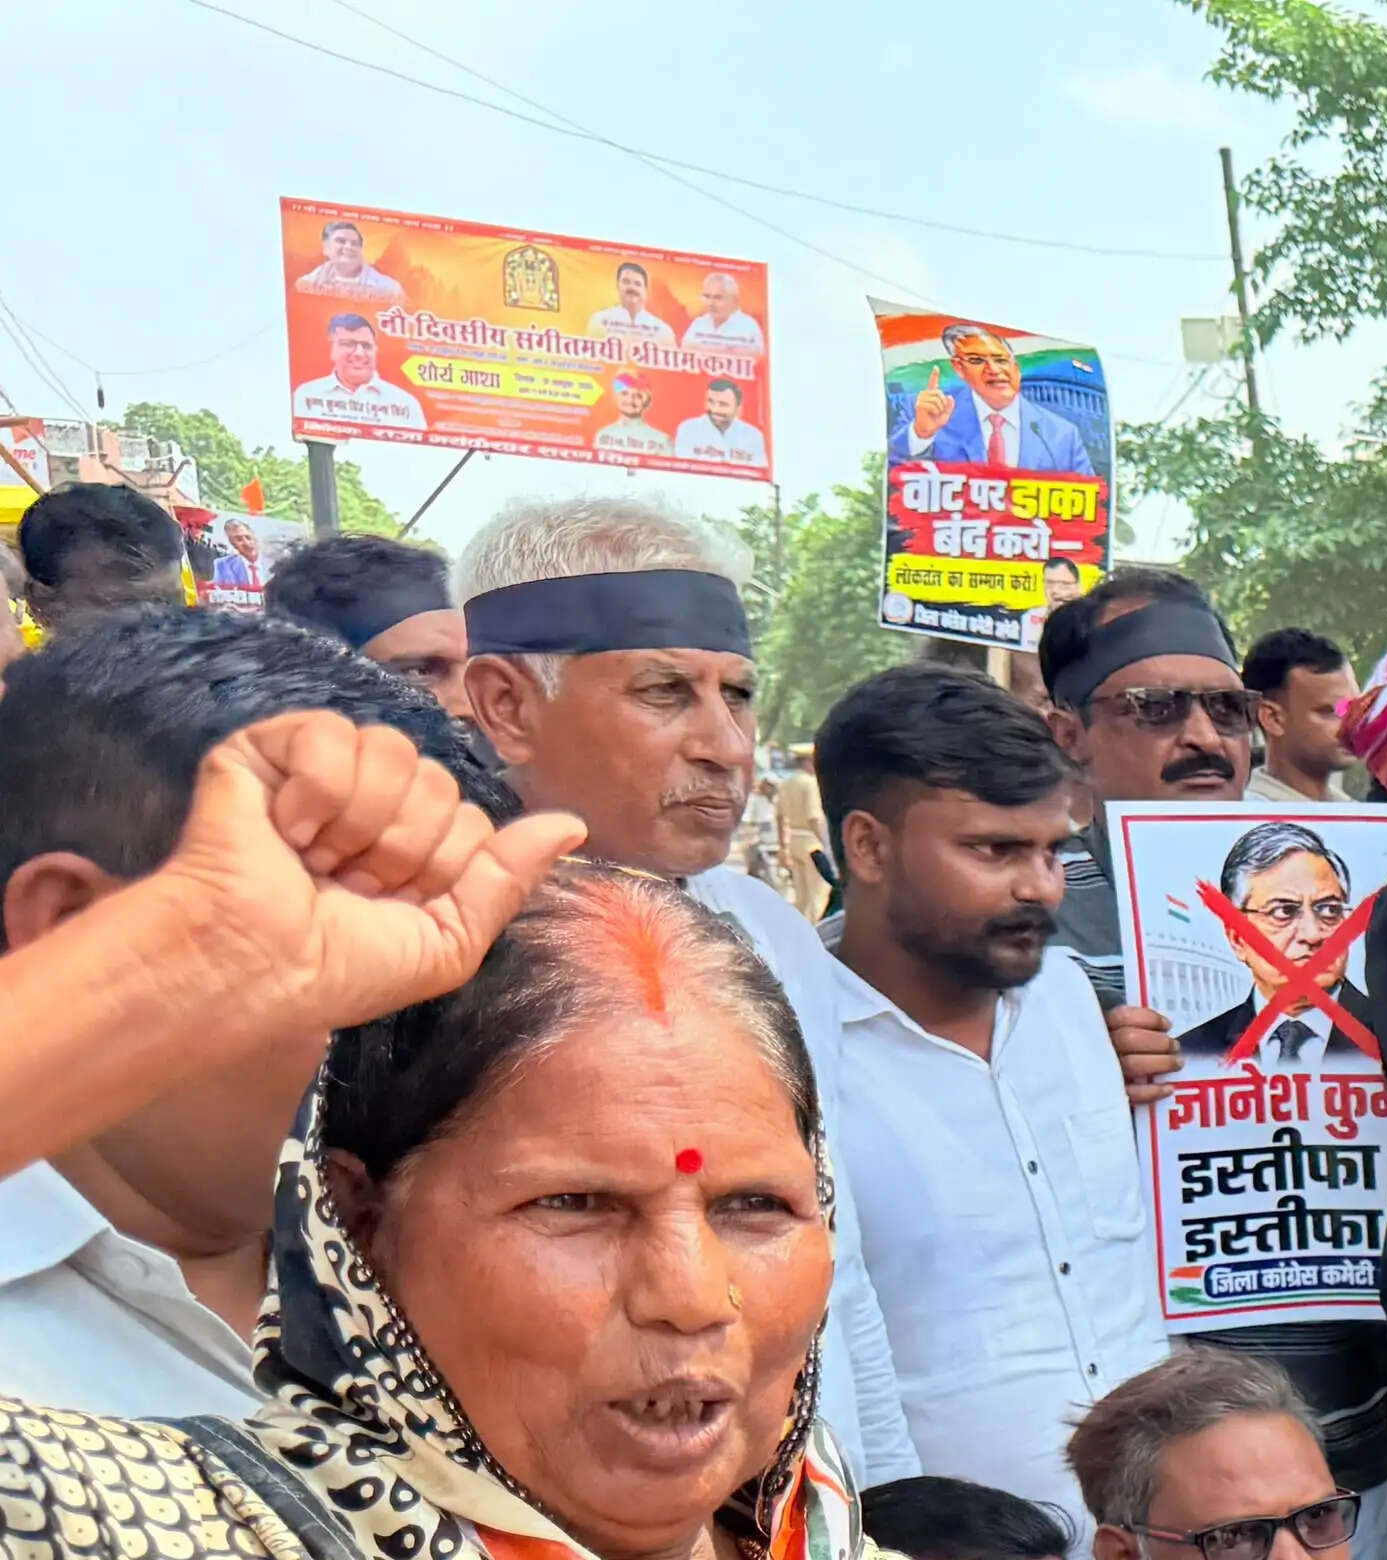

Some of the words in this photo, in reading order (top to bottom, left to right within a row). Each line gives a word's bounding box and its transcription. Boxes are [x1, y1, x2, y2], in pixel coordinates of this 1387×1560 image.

[417, 313, 506, 346] दिवसीय
[901, 465, 966, 513] वोट
[969, 478, 1008, 512] पर
[1010, 479, 1099, 521] डाका
[933, 513, 990, 558] बंद
[947, 572, 964, 588] का
[1167, 1062, 1312, 1130] ज्ञानेश
[1178, 1127, 1380, 1203] इस्तीफा
[1181, 1195, 1384, 1263] इस्तीफा
[1211, 1266, 1260, 1294] जिला
[1261, 1262, 1318, 1289] कांग्रेस
[1321, 1259, 1376, 1286] कमेटी
